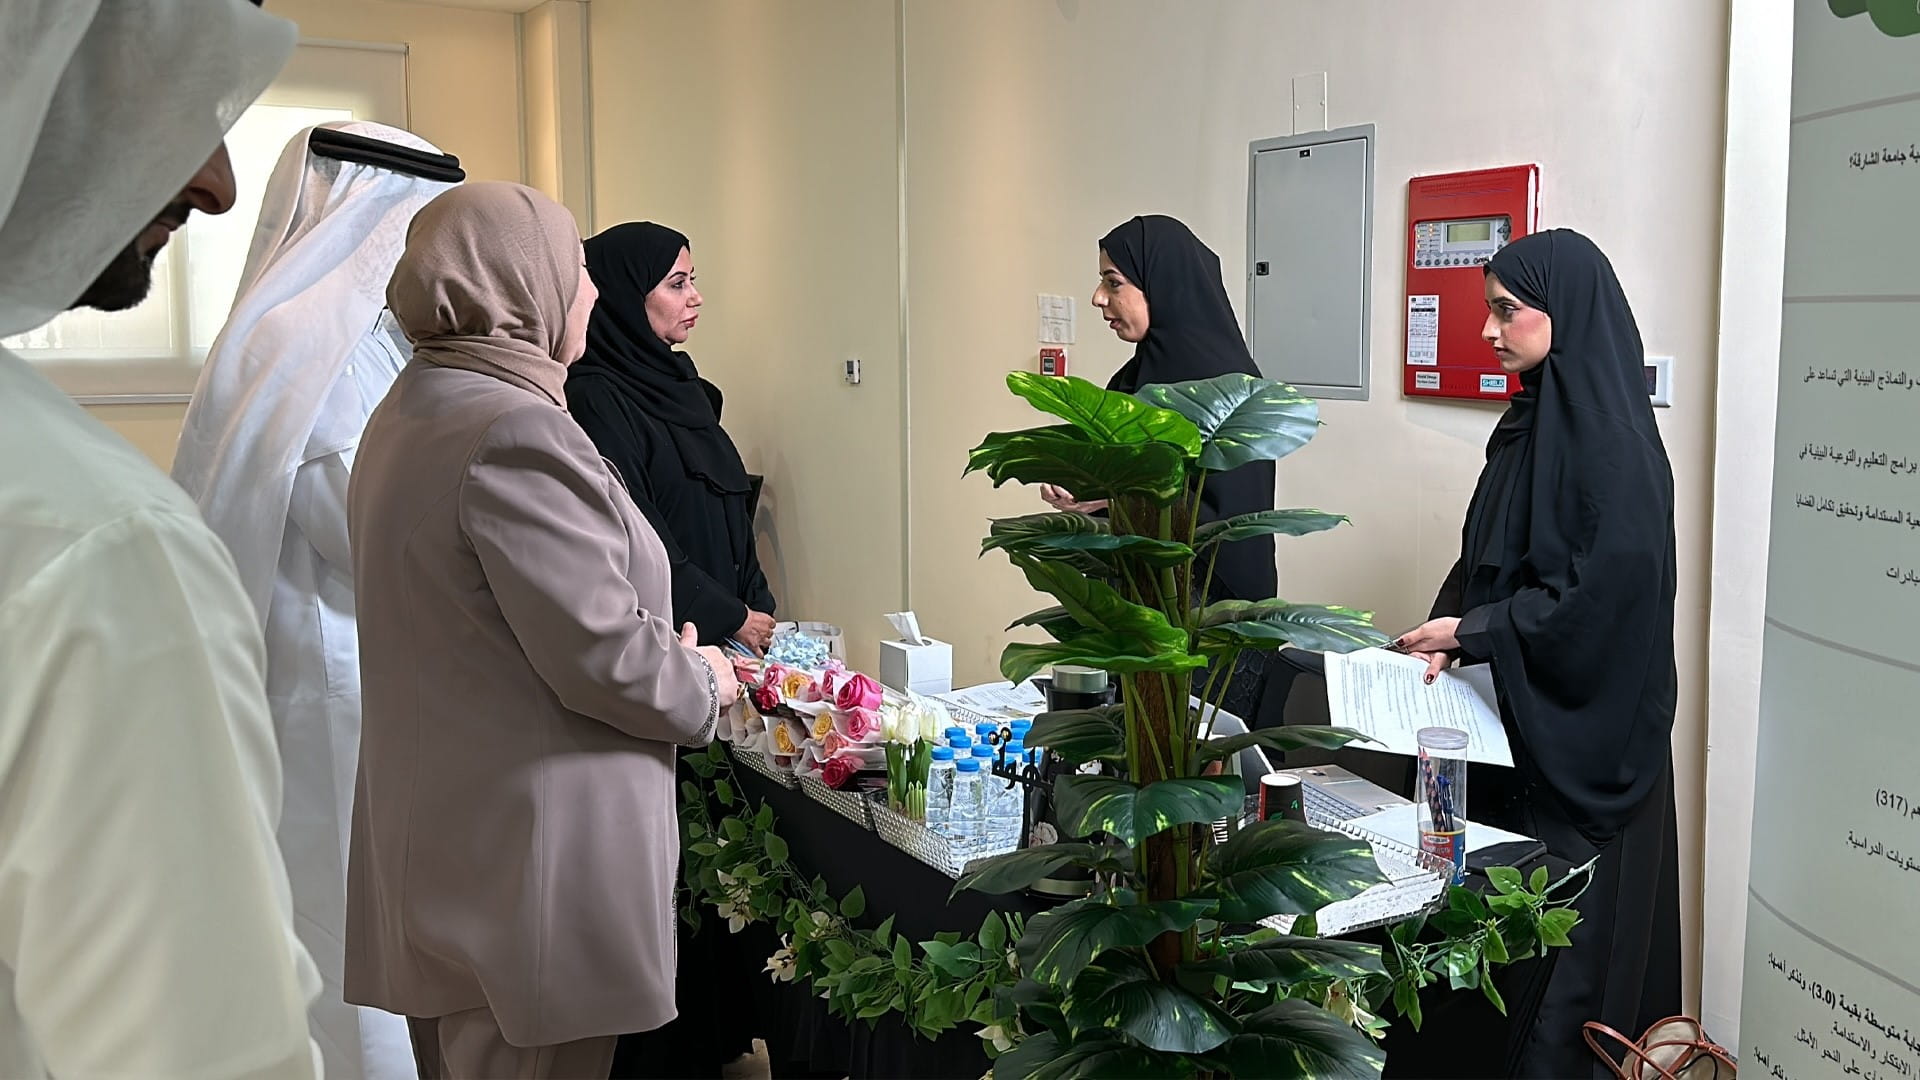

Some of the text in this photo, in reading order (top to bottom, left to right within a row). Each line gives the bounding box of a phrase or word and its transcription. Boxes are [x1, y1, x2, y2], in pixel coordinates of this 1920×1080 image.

[1882, 148, 1906, 166] جامعة
[1804, 366, 1815, 383] على
[1818, 368, 1836, 380] تساعد
[1838, 368, 1852, 387] التي
[1799, 444, 1807, 460] في
[1863, 451, 1887, 470] التعليم
[1890, 457, 1917, 475] برامج
[1796, 494, 1815, 508] القضايا
[1816, 496, 1835, 512] تكامل
[1836, 502, 1863, 521] وتحقيق
[1865, 505, 1903, 524] المستدامة
[1886, 568, 1920, 586] بادرات
[1876, 789, 1908, 817] (317)
[1787, 968, 1806, 990] ونذكر
[1839, 994, 1861, 1023] بقيمة
[1864, 1008, 1901, 1040] متوسطة
[1821, 1049, 1840, 1063] النحو
[1879, 1050, 1912, 1076] الابتكار
[1843, 1058, 1860, 1075] على
